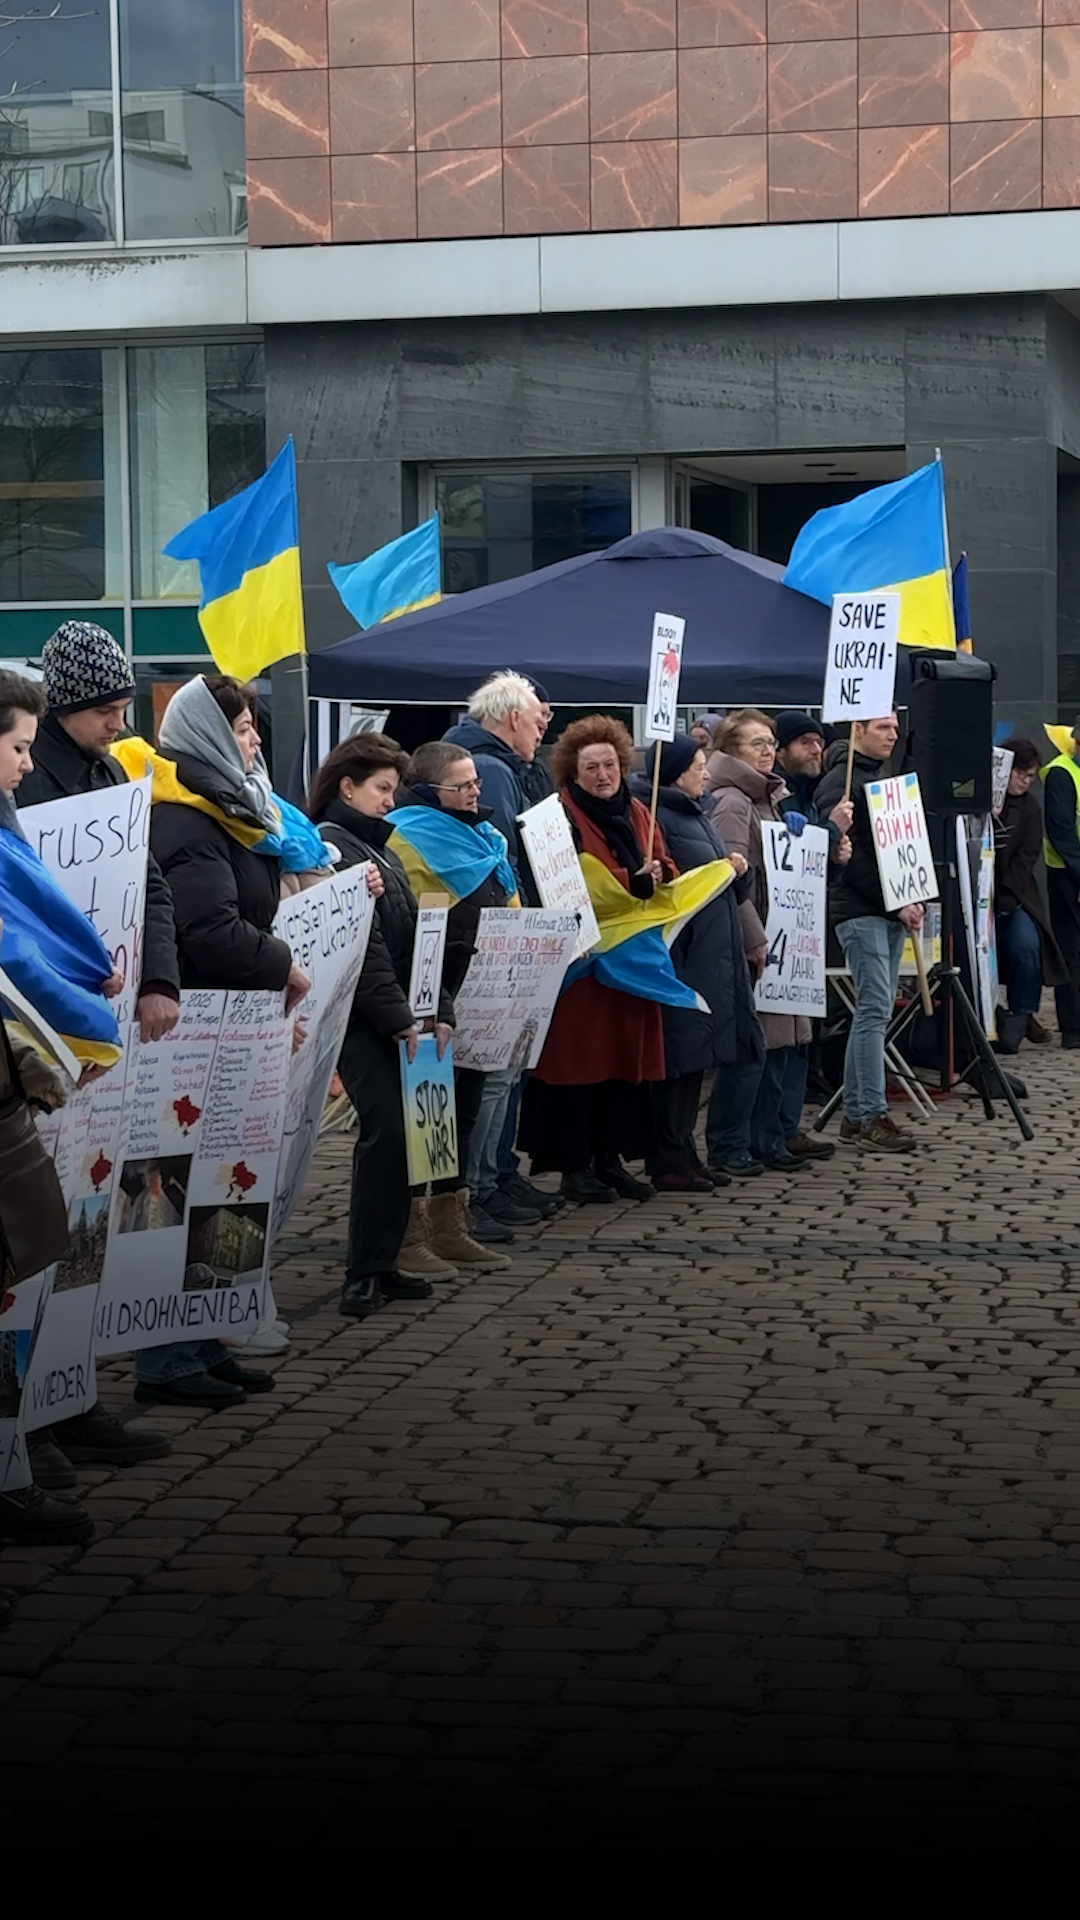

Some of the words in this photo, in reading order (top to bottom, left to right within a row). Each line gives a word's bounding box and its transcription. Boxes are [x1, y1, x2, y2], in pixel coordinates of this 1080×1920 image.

[839, 602, 886, 629] SAVE
[834, 641, 893, 670] UKRAI-
[839, 678, 863, 705] NE
[770, 828, 794, 872] 12
[897, 845, 917, 870] NO
[889, 862, 930, 901] WAR
[765, 928, 788, 976] 4
[415, 1080, 448, 1129] STOP
[424, 1116, 456, 1176] WAR!
[117, 1291, 226, 1336] DROHNEN!
[32, 1364, 86, 1411] WIEDER
